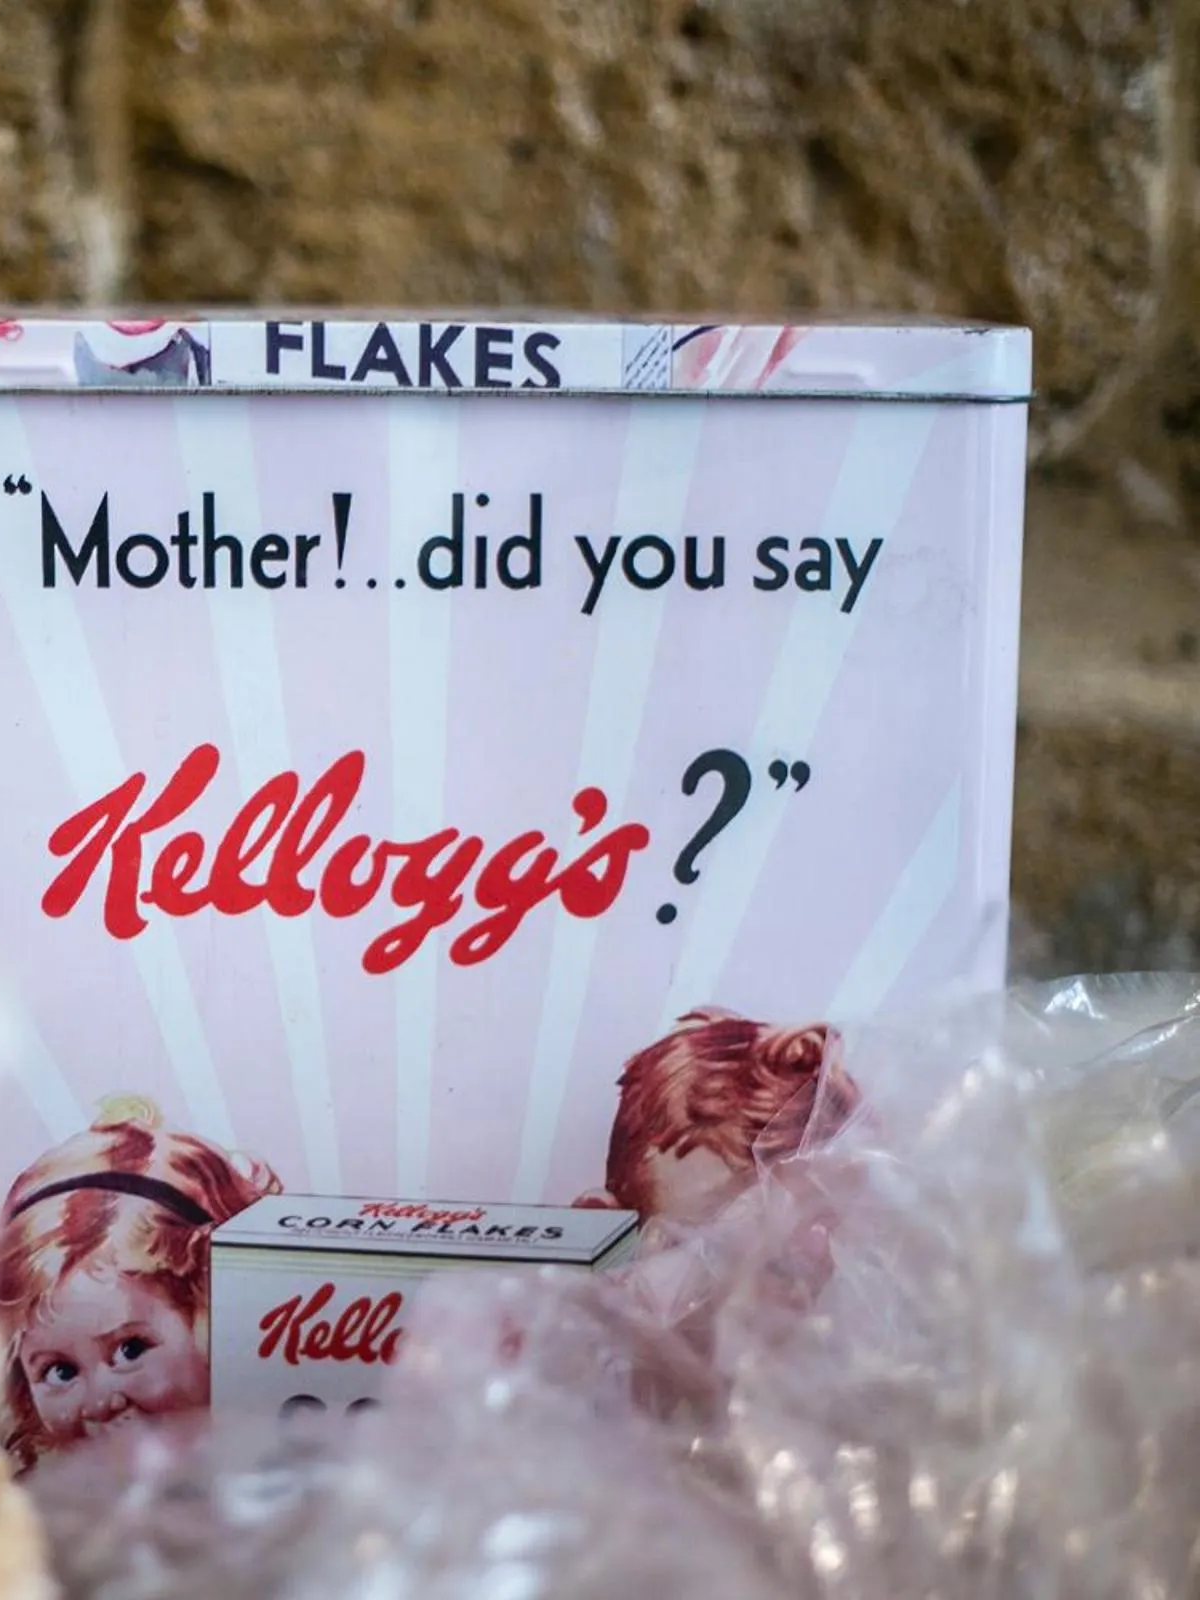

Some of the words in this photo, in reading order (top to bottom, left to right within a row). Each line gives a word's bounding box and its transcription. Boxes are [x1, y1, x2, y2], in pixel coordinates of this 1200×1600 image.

[266, 321, 561, 388] FLAKES
[574, 535, 725, 616] you
[753, 536, 884, 615] say
[276, 1215, 397, 1232] CORN
[410, 1218, 565, 1241] FLAKES
